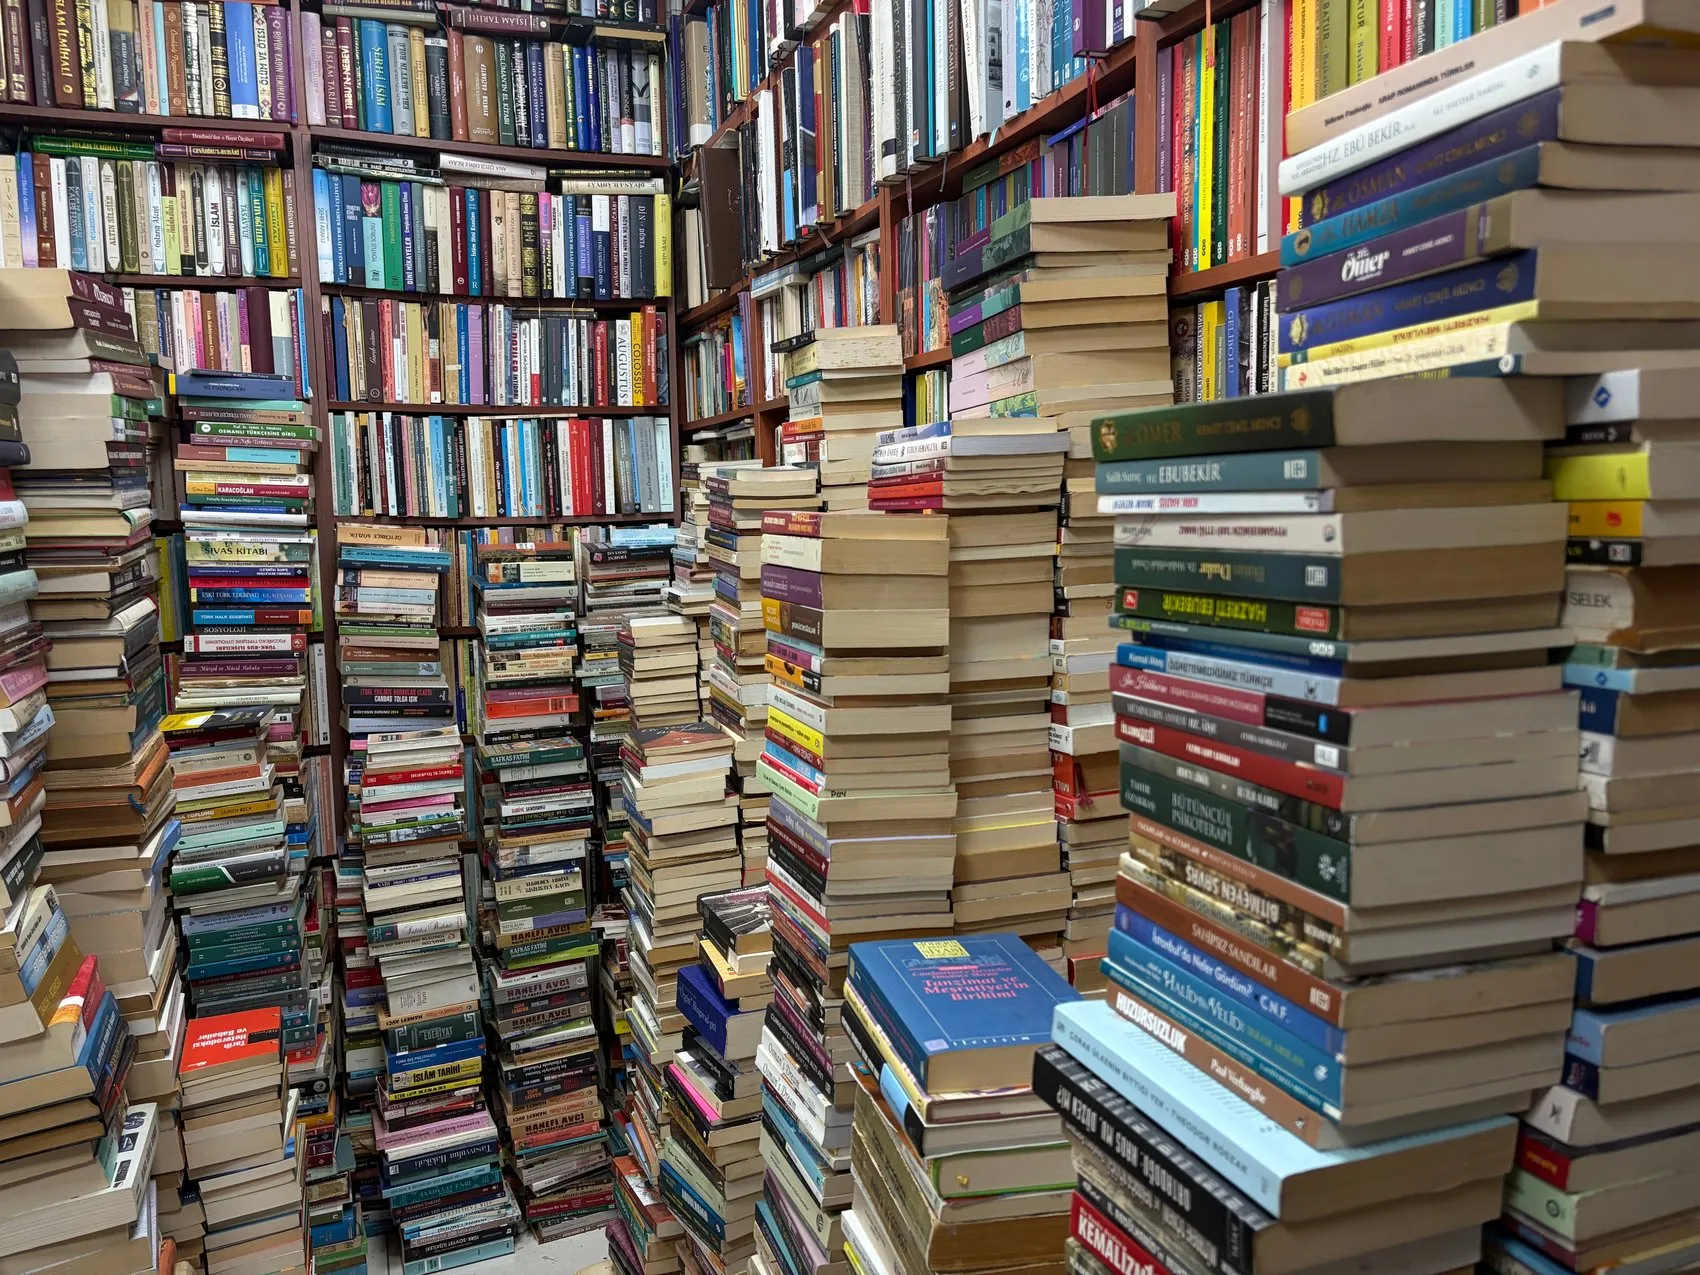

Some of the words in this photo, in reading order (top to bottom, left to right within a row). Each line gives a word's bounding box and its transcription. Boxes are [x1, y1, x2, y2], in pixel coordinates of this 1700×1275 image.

[1322, 2, 1330, 40] BATUR
[617, 337, 628, 399] AUGUSTUS
[632, 343, 642, 394] COLOSSUS
[951, 990, 1017, 1001] Birikimi
[1116, 991, 1188, 1054] HUZURSUZLUK
[223, 1040, 246, 1050] Tarih
[1210, 1057, 1228, 1076] Paul
